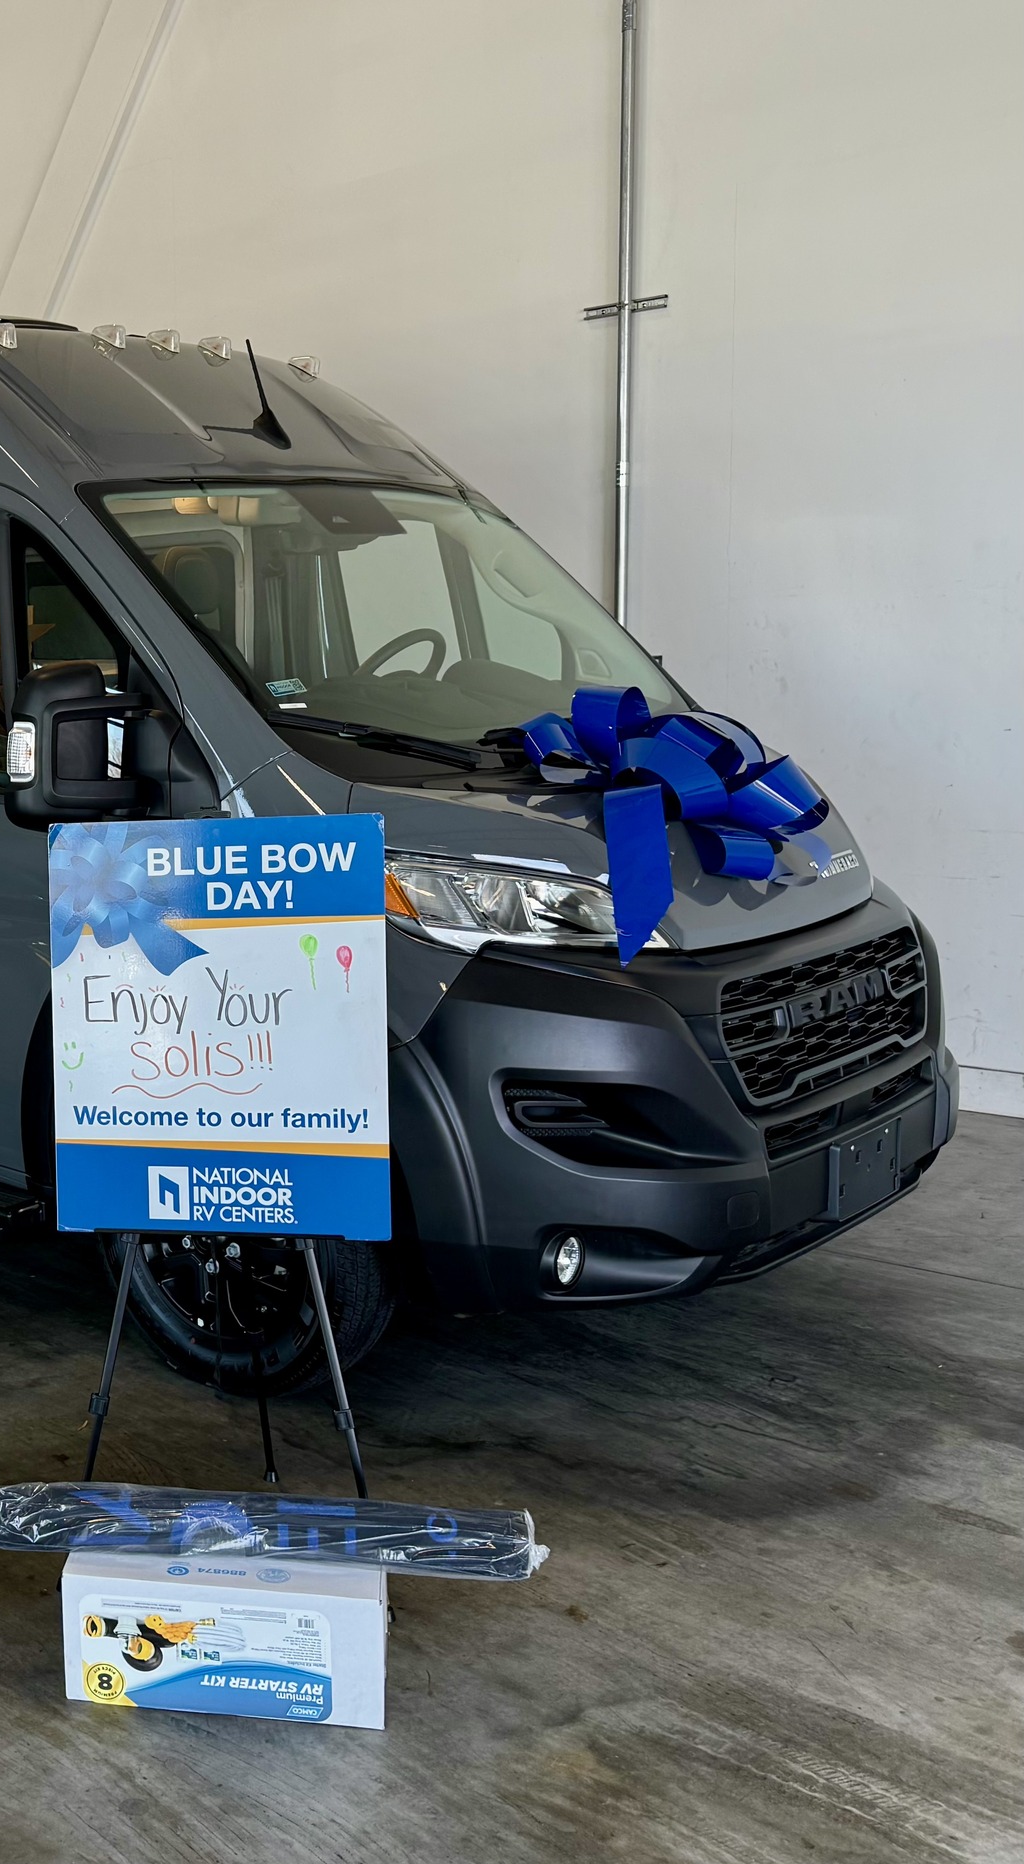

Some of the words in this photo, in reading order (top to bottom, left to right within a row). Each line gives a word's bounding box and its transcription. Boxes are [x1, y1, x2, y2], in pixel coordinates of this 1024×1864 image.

[146, 845, 248, 877] BLUE
[261, 841, 357, 874] BOW
[206, 879, 294, 911] DAY!
[83, 974, 188, 1035] Enjoy
[205, 966, 293, 1027] Your
[787, 967, 886, 1029] RAM
[73, 1105, 188, 1126] Welcome
[196, 1108, 222, 1127] to
[230, 1111, 274, 1128] our
[281, 1107, 369, 1134] family!
[192, 1167, 293, 1187] NATIONAL
[192, 1186, 294, 1207] INDOOR
[193, 1206, 215, 1222] RV
[97, 1673, 113, 1691] 8
[200, 1674, 227, 1687] KIT
[229, 1676, 298, 1693] STARTER
[300, 1682, 324, 1696] RV
[276, 1691, 324, 1705] Premium
[292, 1707, 317, 1716] CAMCO
